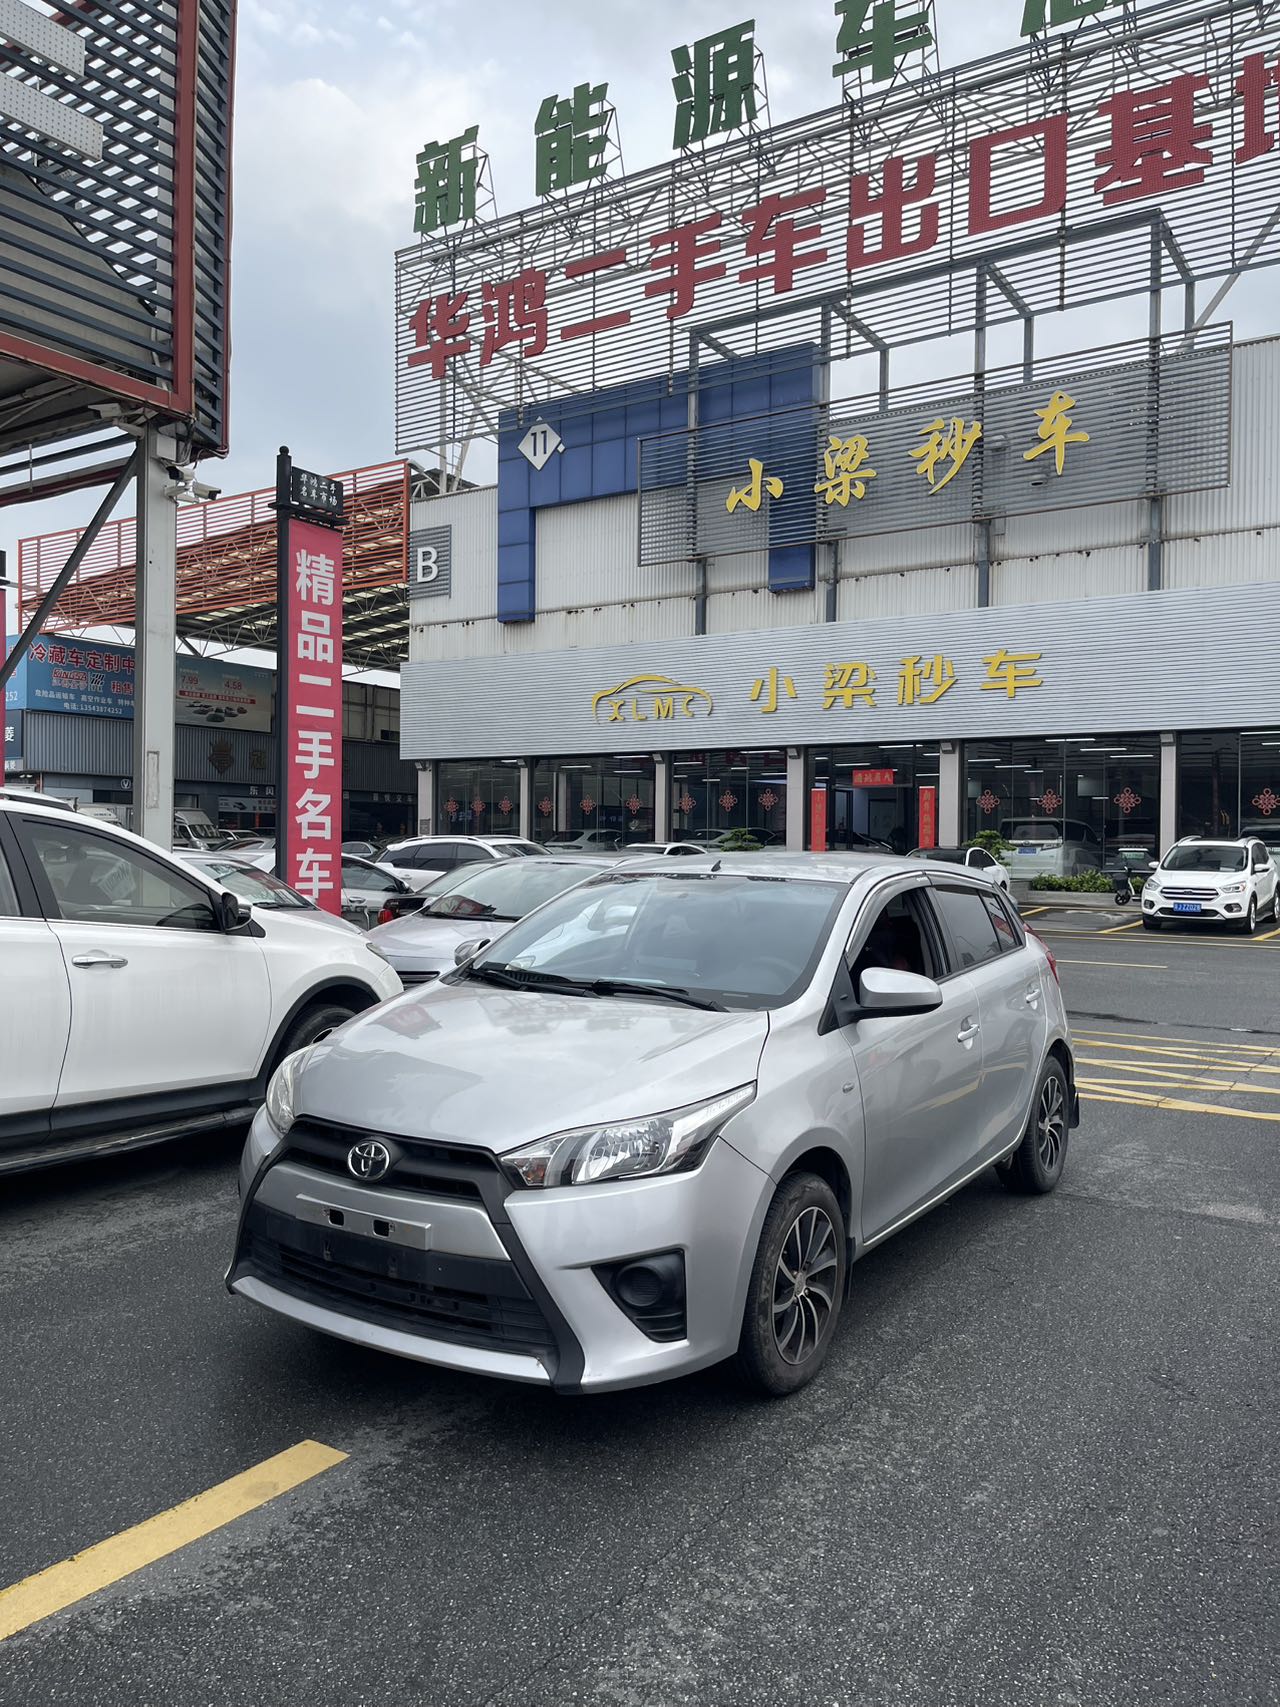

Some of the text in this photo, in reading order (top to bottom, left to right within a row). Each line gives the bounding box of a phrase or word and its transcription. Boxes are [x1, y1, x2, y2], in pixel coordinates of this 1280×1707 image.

[413, 0, 1136, 234] 新能源车
[531, 429, 548, 457] 11
[725, 389, 1090, 513] 小梁秒车
[416, 546, 439, 583] B
[608, 694, 695, 721] XLMC
[749, 648, 1043, 714] 小梁秒车
[295, 549, 335, 899] 精品二手名车
